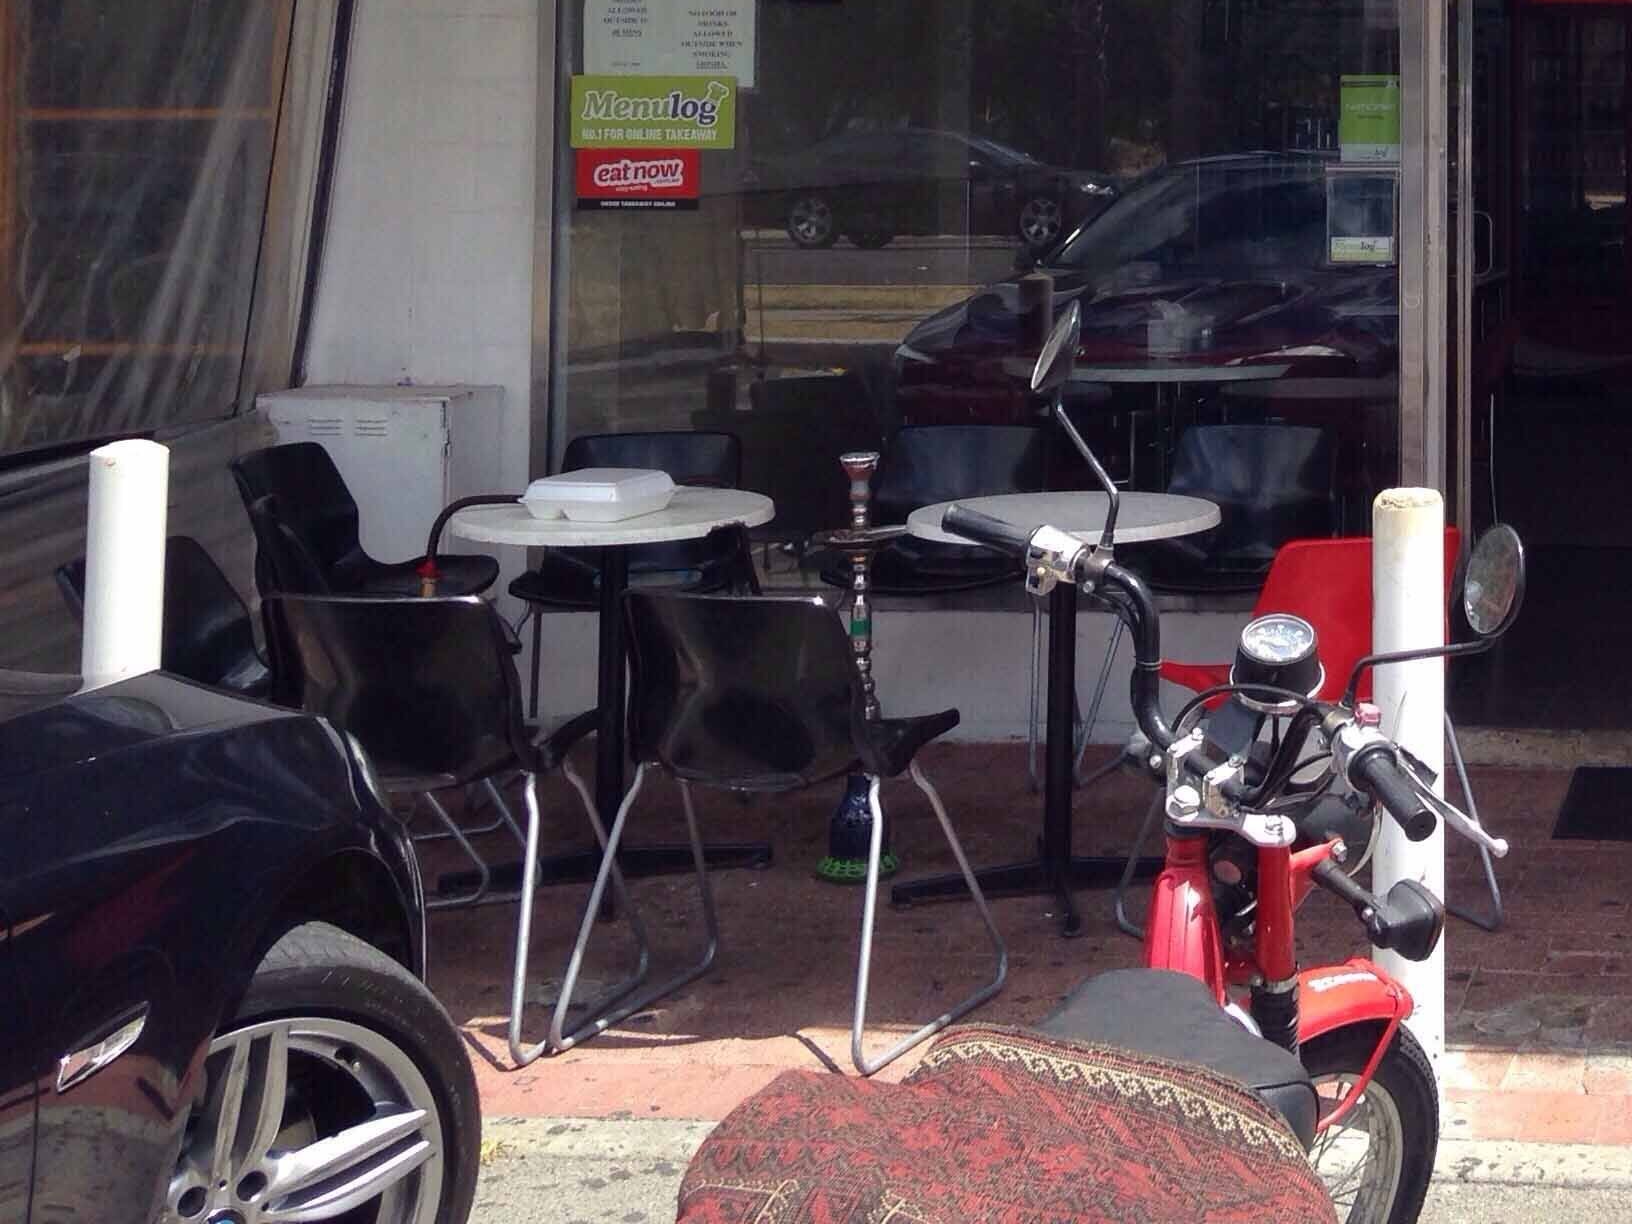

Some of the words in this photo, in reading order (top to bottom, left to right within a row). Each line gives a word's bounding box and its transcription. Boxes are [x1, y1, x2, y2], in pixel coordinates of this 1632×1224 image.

[582, 91, 717, 127] Menulog
[602, 128, 624, 141] FOR
[665, 128, 717, 141] TAKEAWAY
